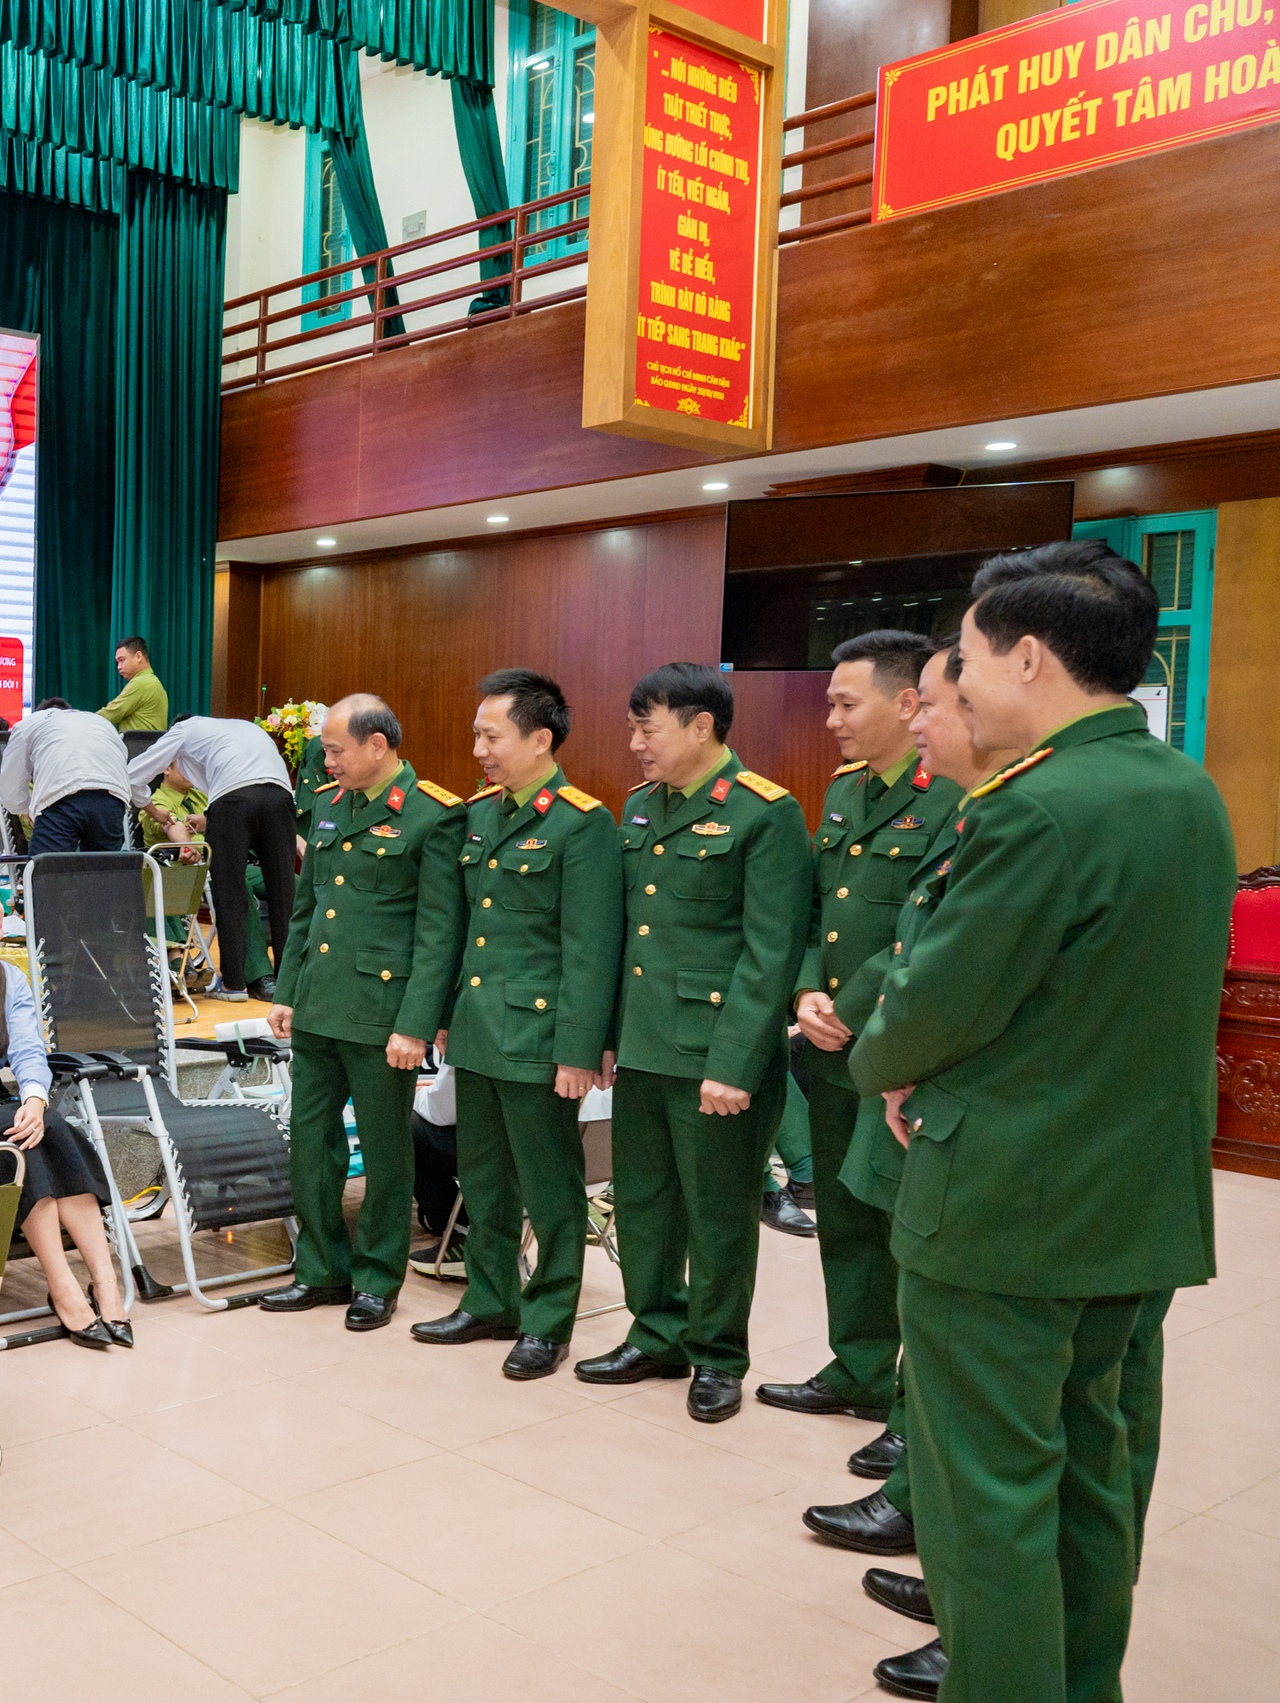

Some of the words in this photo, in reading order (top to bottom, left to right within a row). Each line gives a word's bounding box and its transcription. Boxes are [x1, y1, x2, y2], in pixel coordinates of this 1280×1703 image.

[670, 57, 686, 83] NÓI
[688, 65, 716, 95] NHỮNG
[926, 62, 1010, 122] PHÁT
[1017, 40, 1086, 95] HUY
[1094, 14, 1172, 71] DÂN
[664, 93, 684, 121] THẬT
[686, 101, 708, 128] THIẾT
[709, 110, 732, 141] THỰC,
[995, 90, 1103, 162] QUYẾT
[1112, 73, 1193, 129] TÂM
[665, 133, 693, 162] ĐƯỜNG
[694, 141, 708, 167] LỐI
[710, 149, 734, 176] CHÍNH
[657, 165, 666, 190] ÍT
[687, 177, 704, 203] VIẾT
[678, 210, 697, 240] GIẢN
[650, 280, 676, 307] TRÌNH
[678, 287, 694, 312] BÀY
[708, 295, 730, 322] RÀNG
[648, 316, 666, 342] TIẾP
[667, 324, 690, 348] SANG
[692, 330, 718, 356] TRANG
